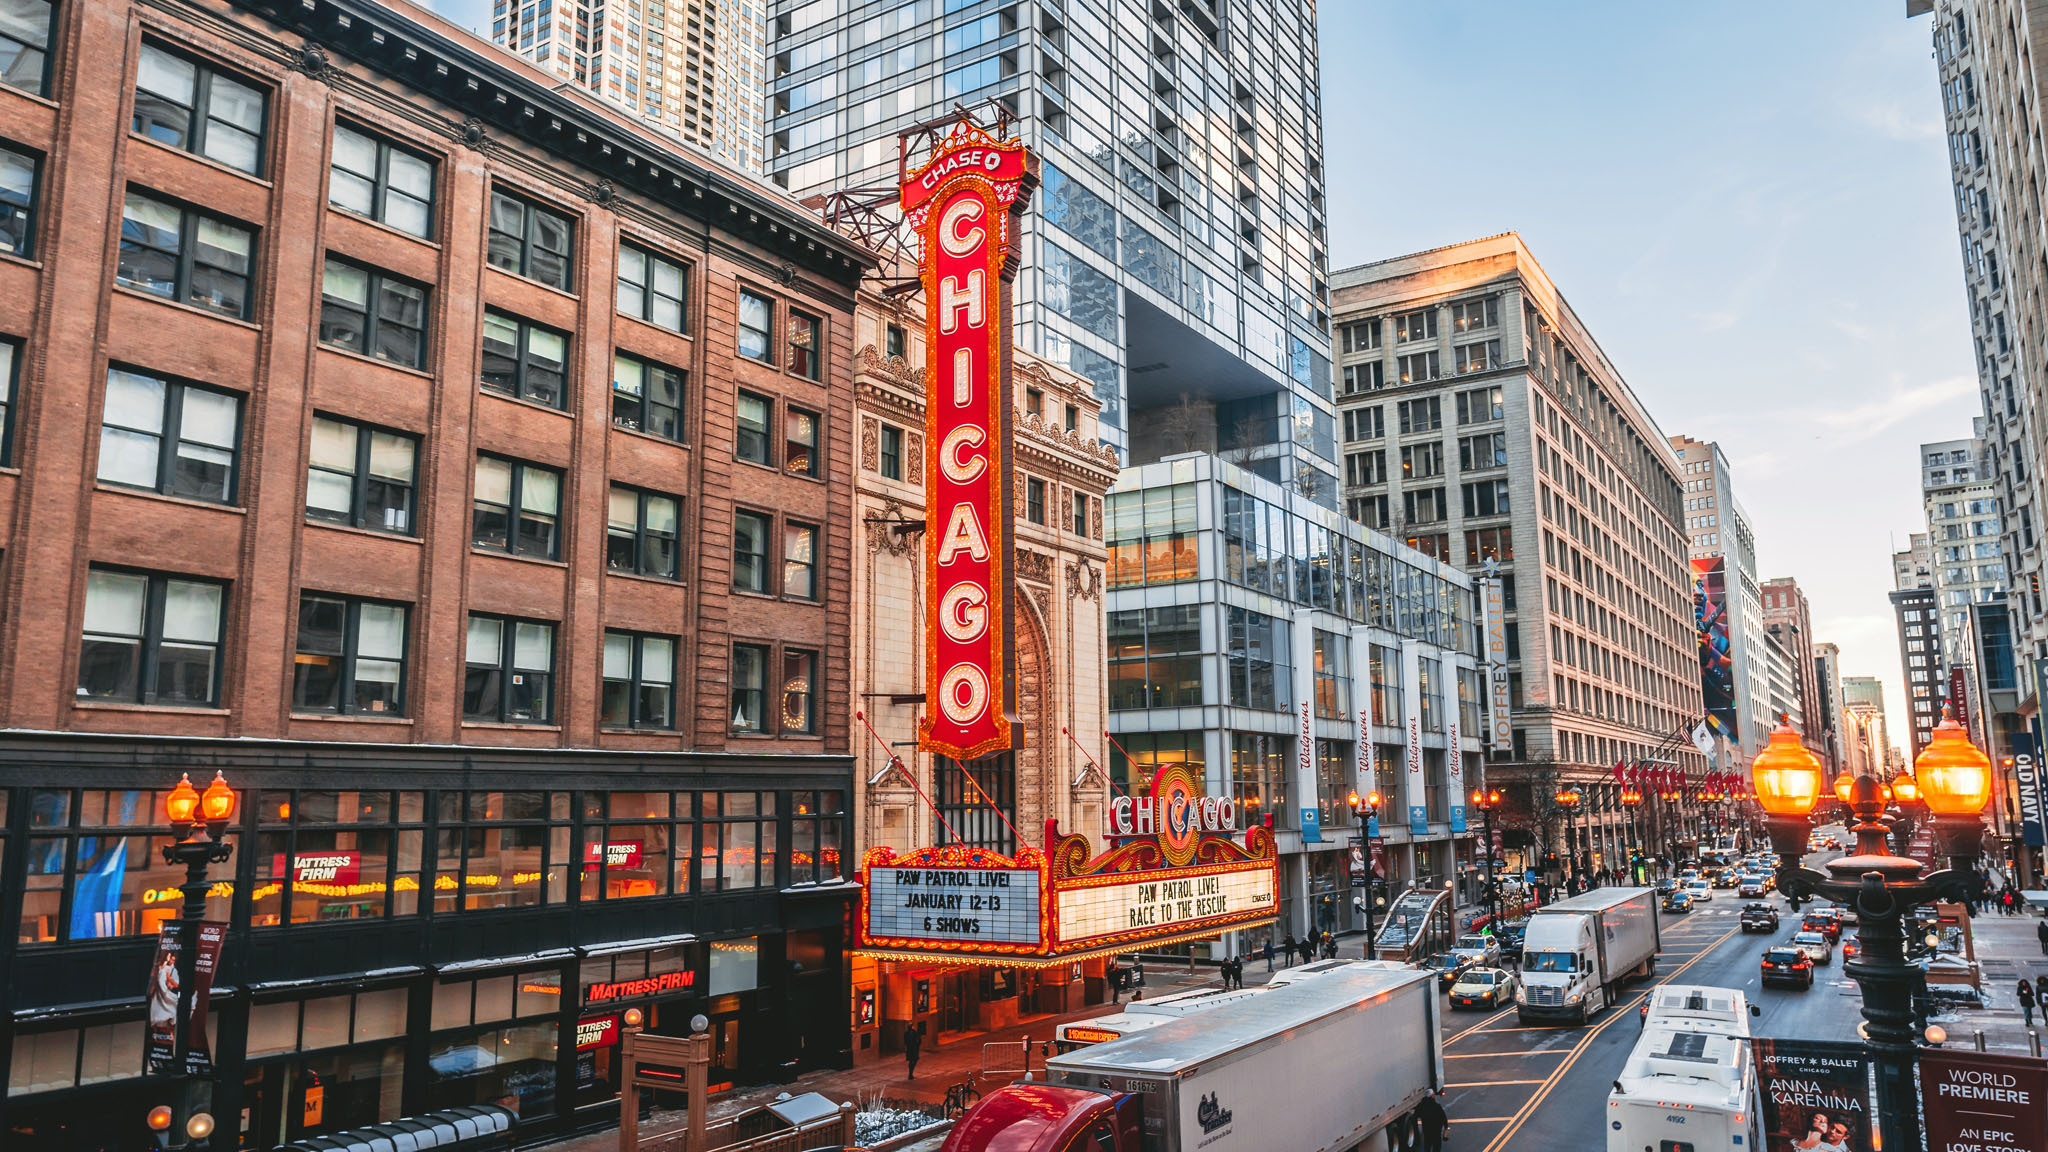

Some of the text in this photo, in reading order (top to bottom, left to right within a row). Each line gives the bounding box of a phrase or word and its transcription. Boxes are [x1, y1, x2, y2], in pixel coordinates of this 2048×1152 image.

[922, 151, 983, 189] CHASE
[939, 198, 990, 726] CHICAGO
[1487, 581, 1512, 748] JOFFREY BALLET
[1299, 700, 1314, 770] Walgreens
[1358, 709, 1372, 772] Walgreens
[1408, 716, 1421, 774] Walgreens
[1450, 723, 1461, 777] Walgreens
[2015, 753, 2040, 824] OLD NAVY
[1114, 795, 1235, 835] CHICAGO
[592, 844, 637, 855] MTTRESS
[299, 867, 337, 881] FIRM
[896, 870, 1010, 888] PAW PATROL LIVE!
[1138, 876, 1220, 905] PAW PATROL LIVE!
[1252, 895, 1266, 903] CHASE
[905, 893, 1001, 911] JANUARY 12-13
[1129, 895, 1227, 928] RACE TO THE RESCUE
[923, 916, 980, 933] 6 SHOWS
[576, 1030, 603, 1045] FIRM
[1763, 1055, 1858, 1068] JOFFREY BALLET
[1127, 1080, 1156, 1092] 161675
[1769, 1079, 1822, 1094] ANNA
[1948, 1069, 2016, 1088] WORLD
[1771, 1091, 1862, 1112] KARENINA
[1939, 1083, 2030, 1105] PREMIERE
[1666, 1114, 1685, 1124] 4192
[1959, 1128, 2015, 1143] AN EPIC
